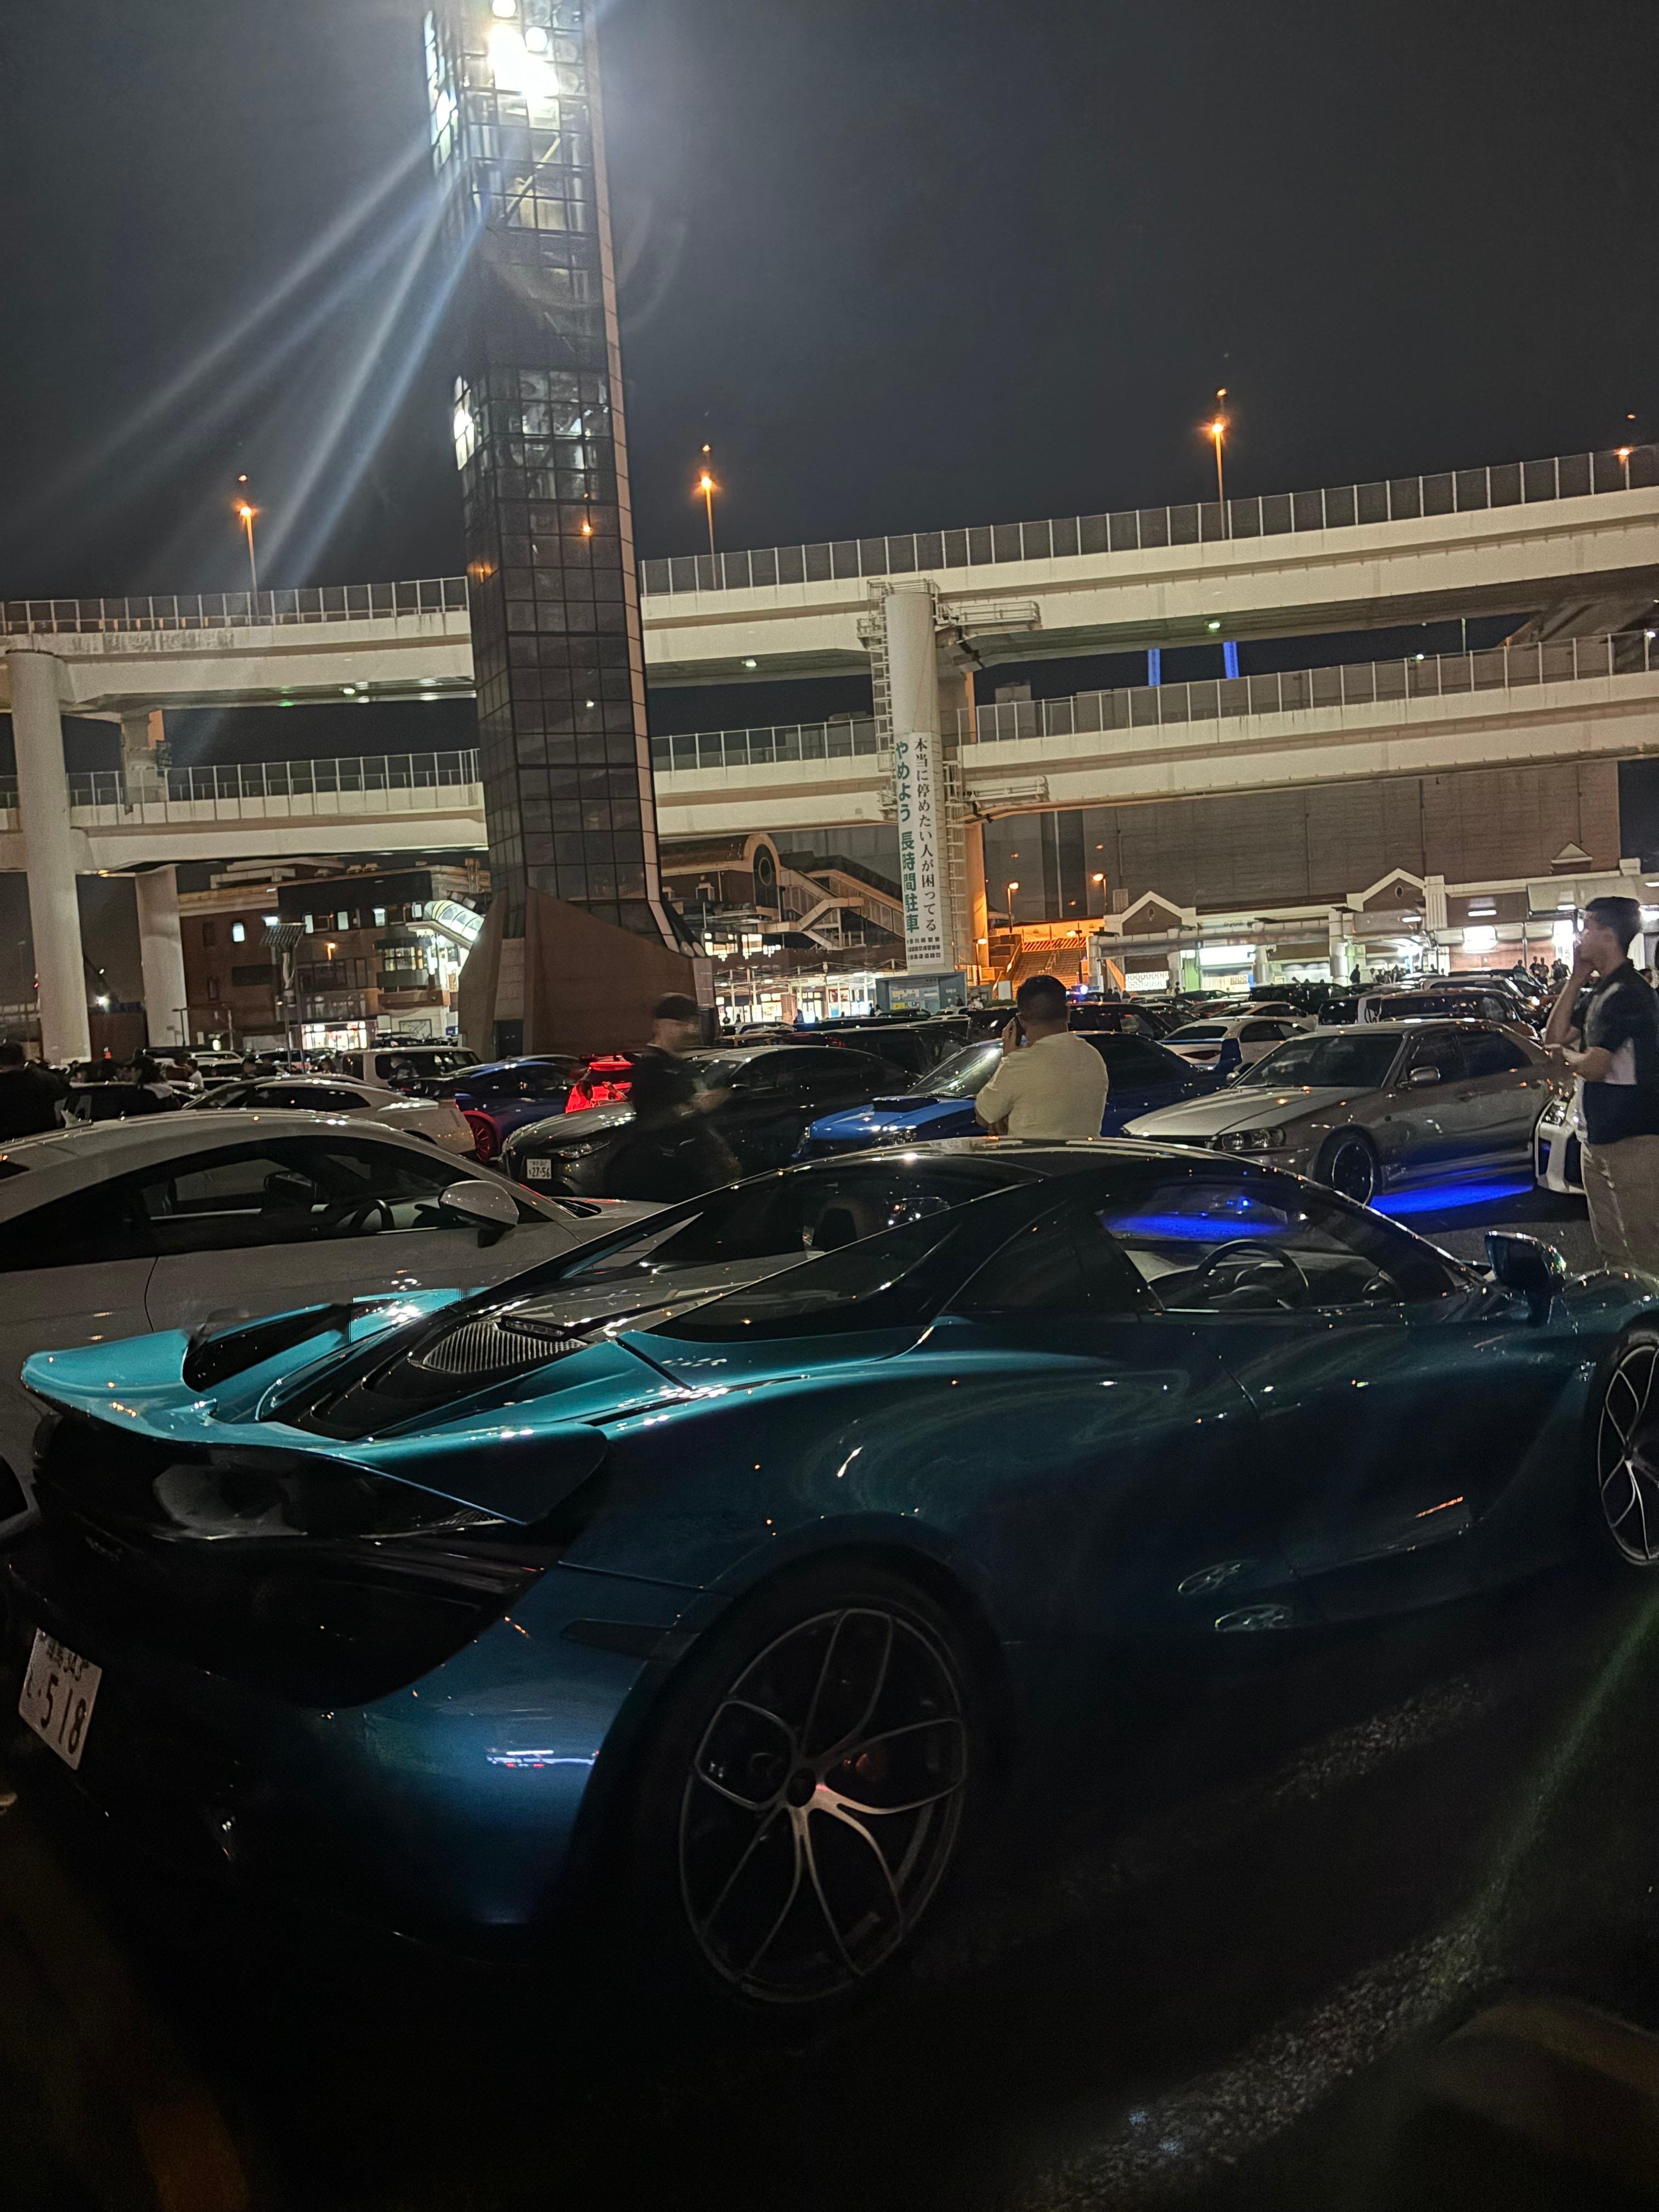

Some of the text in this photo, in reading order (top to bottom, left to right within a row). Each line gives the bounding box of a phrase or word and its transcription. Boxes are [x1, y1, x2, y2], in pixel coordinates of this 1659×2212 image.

[895, 741, 919, 933] やめよう 長時間駐車
[913, 737, 936, 932] 本当に停めたい人が困ってる
